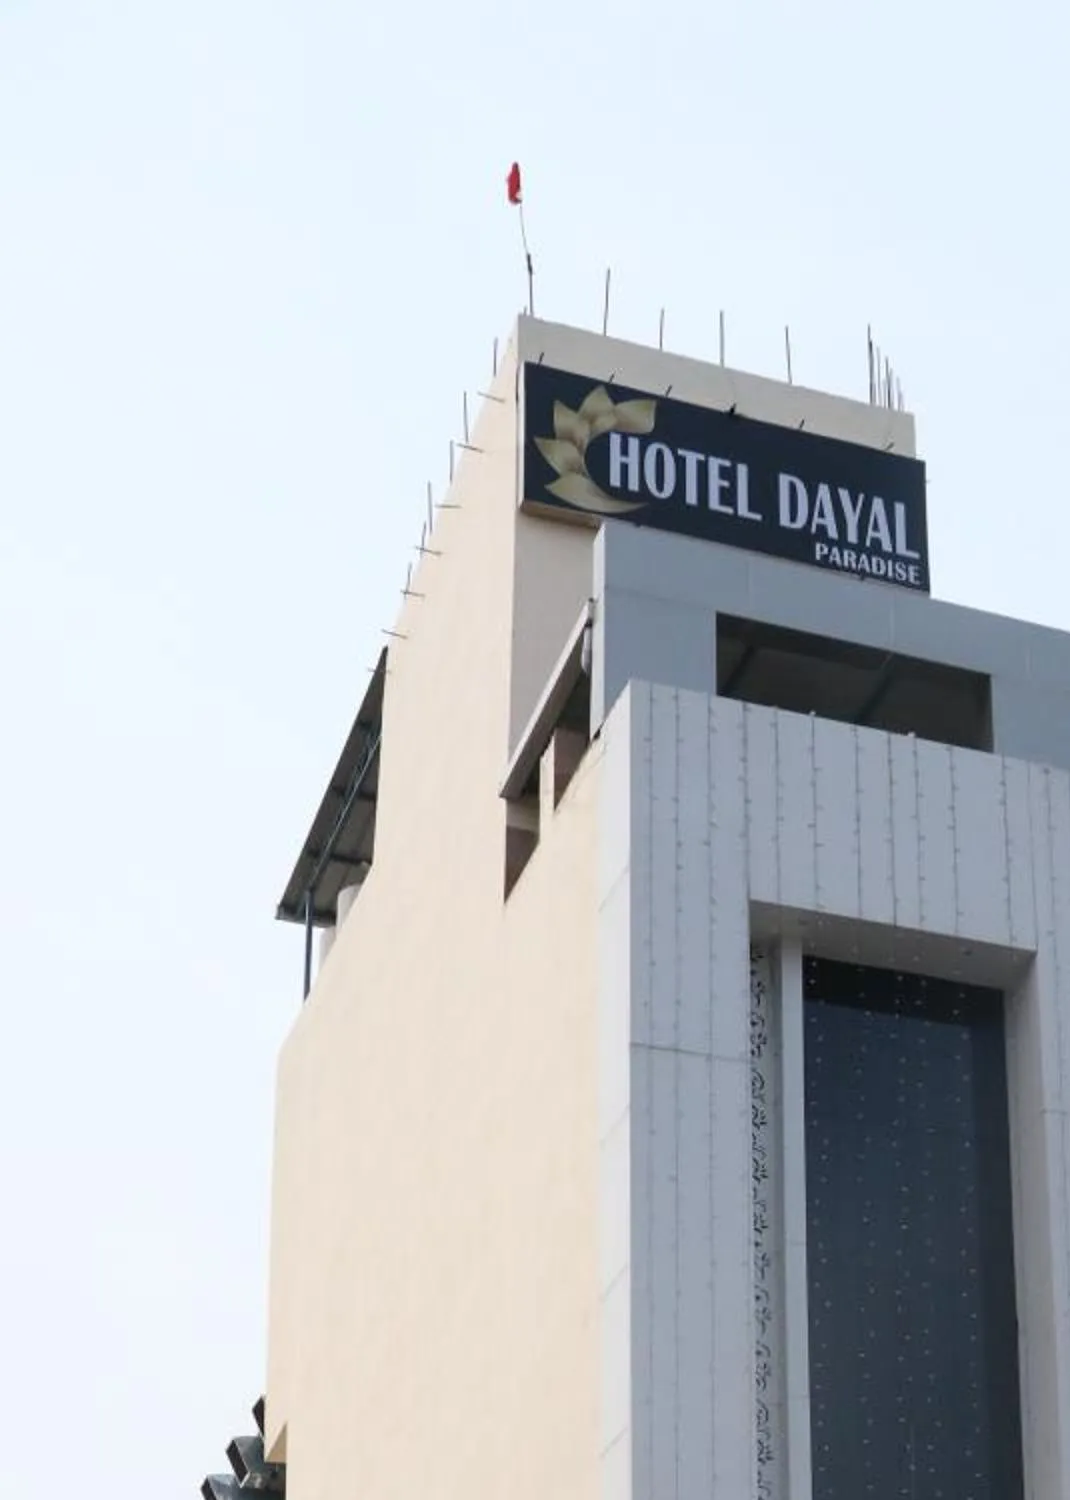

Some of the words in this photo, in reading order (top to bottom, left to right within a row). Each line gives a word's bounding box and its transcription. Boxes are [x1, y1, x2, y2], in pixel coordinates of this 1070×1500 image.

[608, 431, 763, 522] HOTEL
[778, 473, 921, 560] DAYAL
[814, 542, 921, 585] PARADISE
